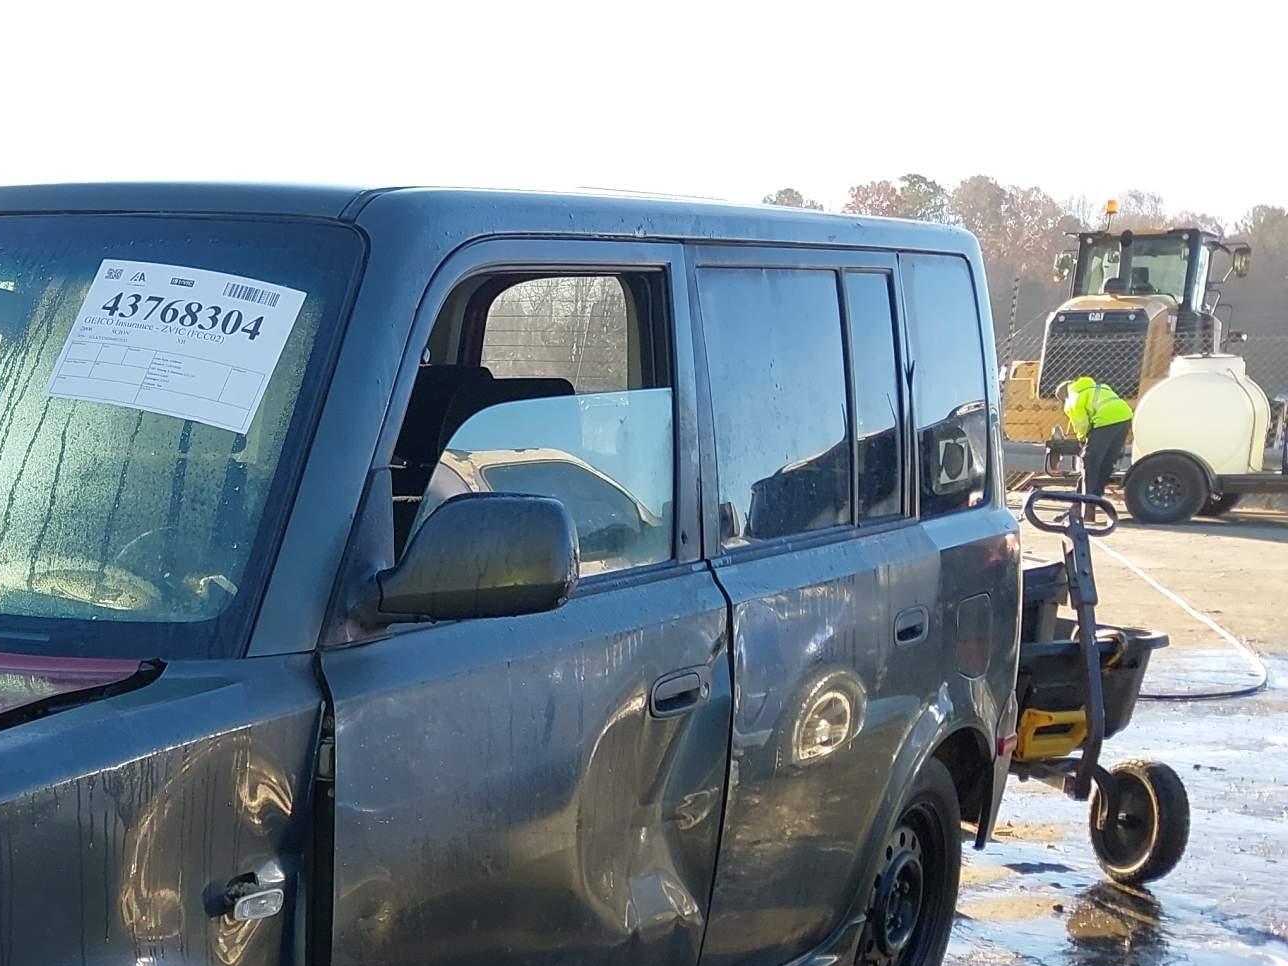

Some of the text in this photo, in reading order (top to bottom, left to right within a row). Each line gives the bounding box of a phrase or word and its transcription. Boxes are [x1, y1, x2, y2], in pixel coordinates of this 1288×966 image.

[84, 316, 114, 326] GEICO
[115, 319, 154, 330] Insurance
[101, 291, 265, 341] 43768304
